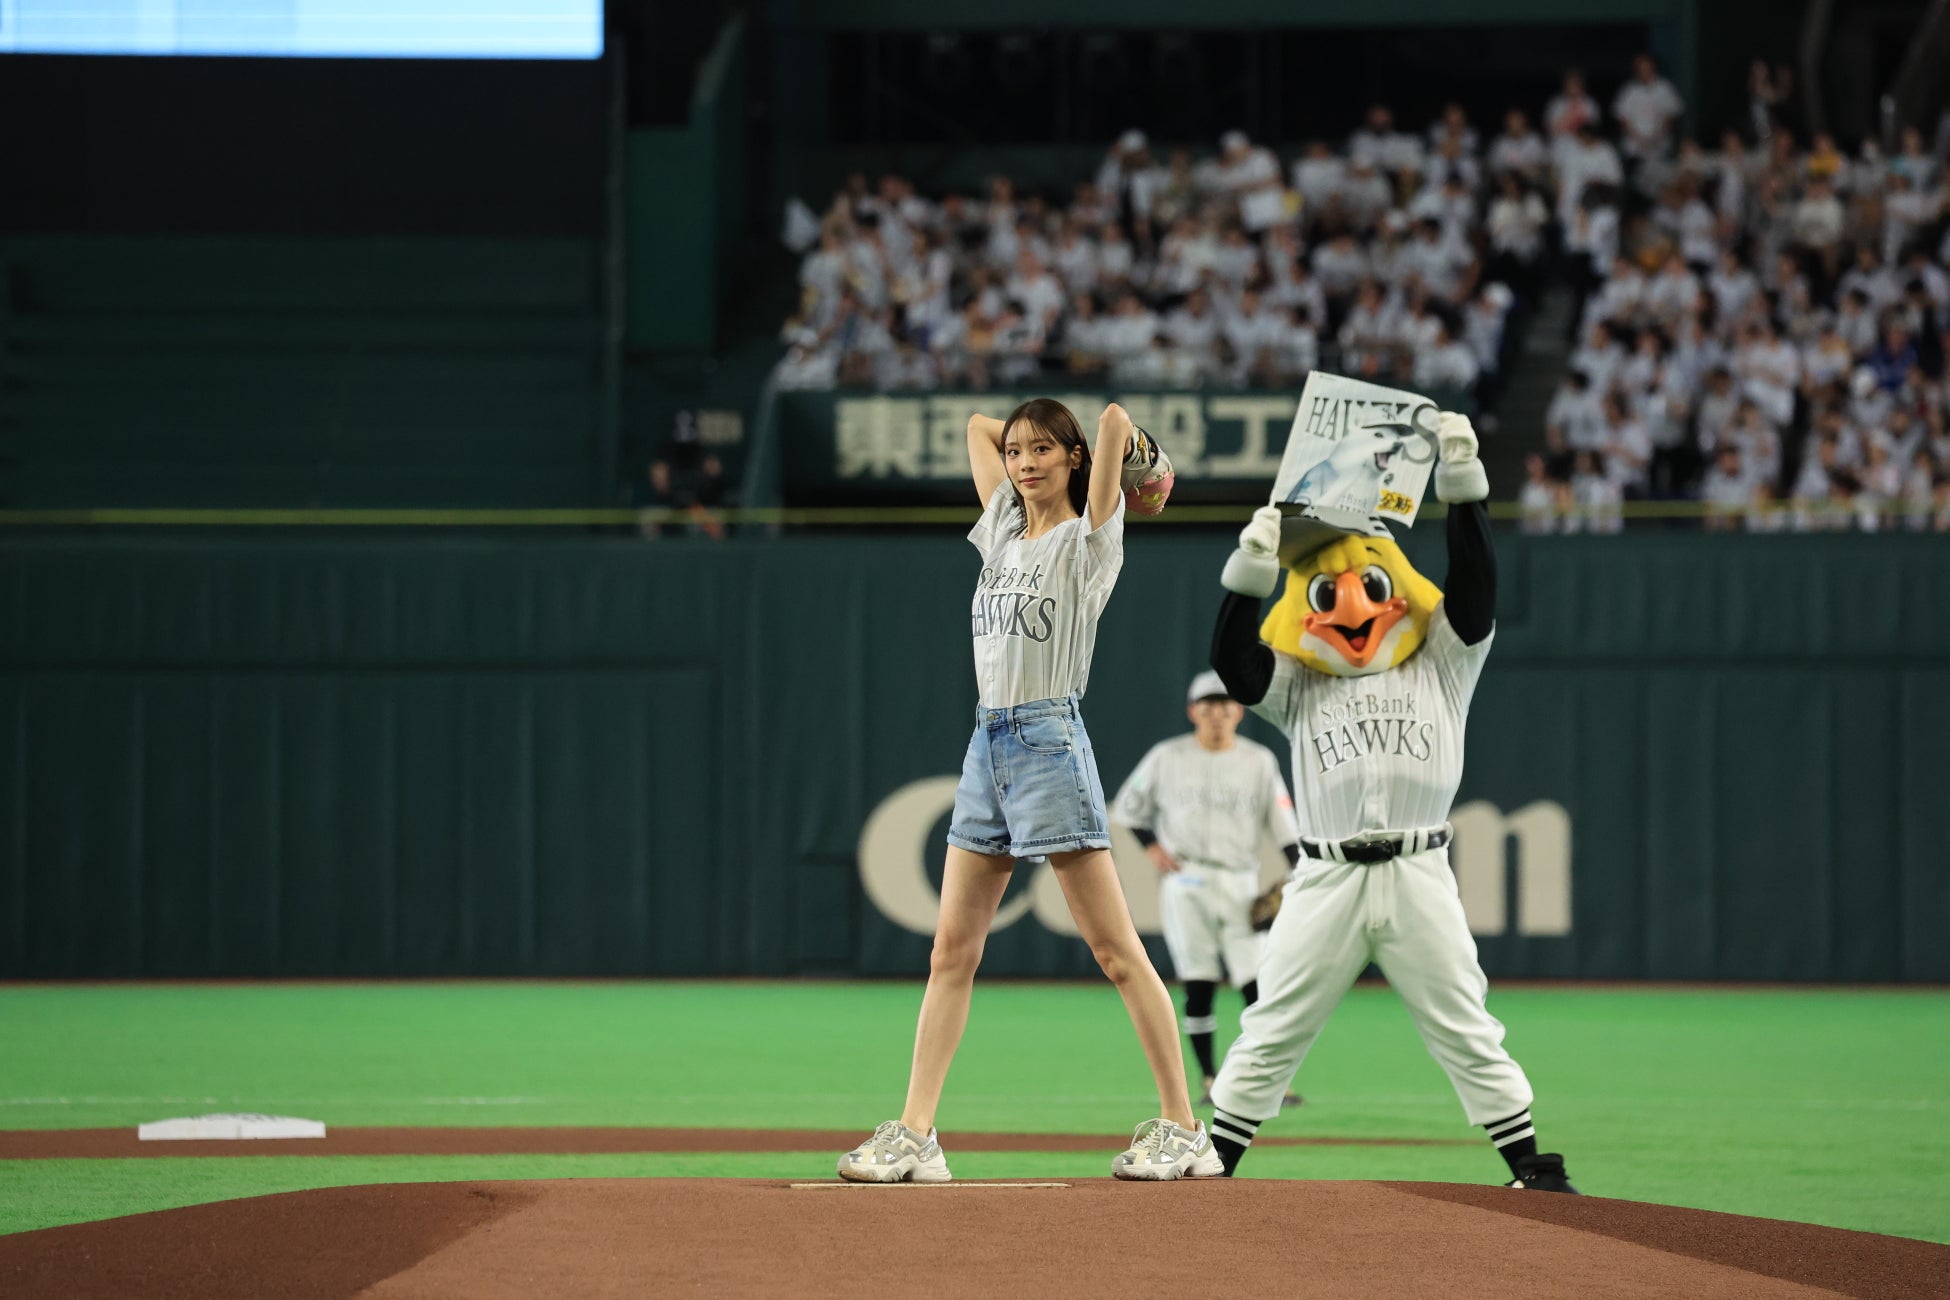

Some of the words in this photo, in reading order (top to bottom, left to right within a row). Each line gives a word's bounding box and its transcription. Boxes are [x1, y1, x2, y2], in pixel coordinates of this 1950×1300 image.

[1305, 397, 1440, 464] HAS
[1321, 693, 1416, 724] SoftBank
[1312, 718, 1433, 775] HAWKS
